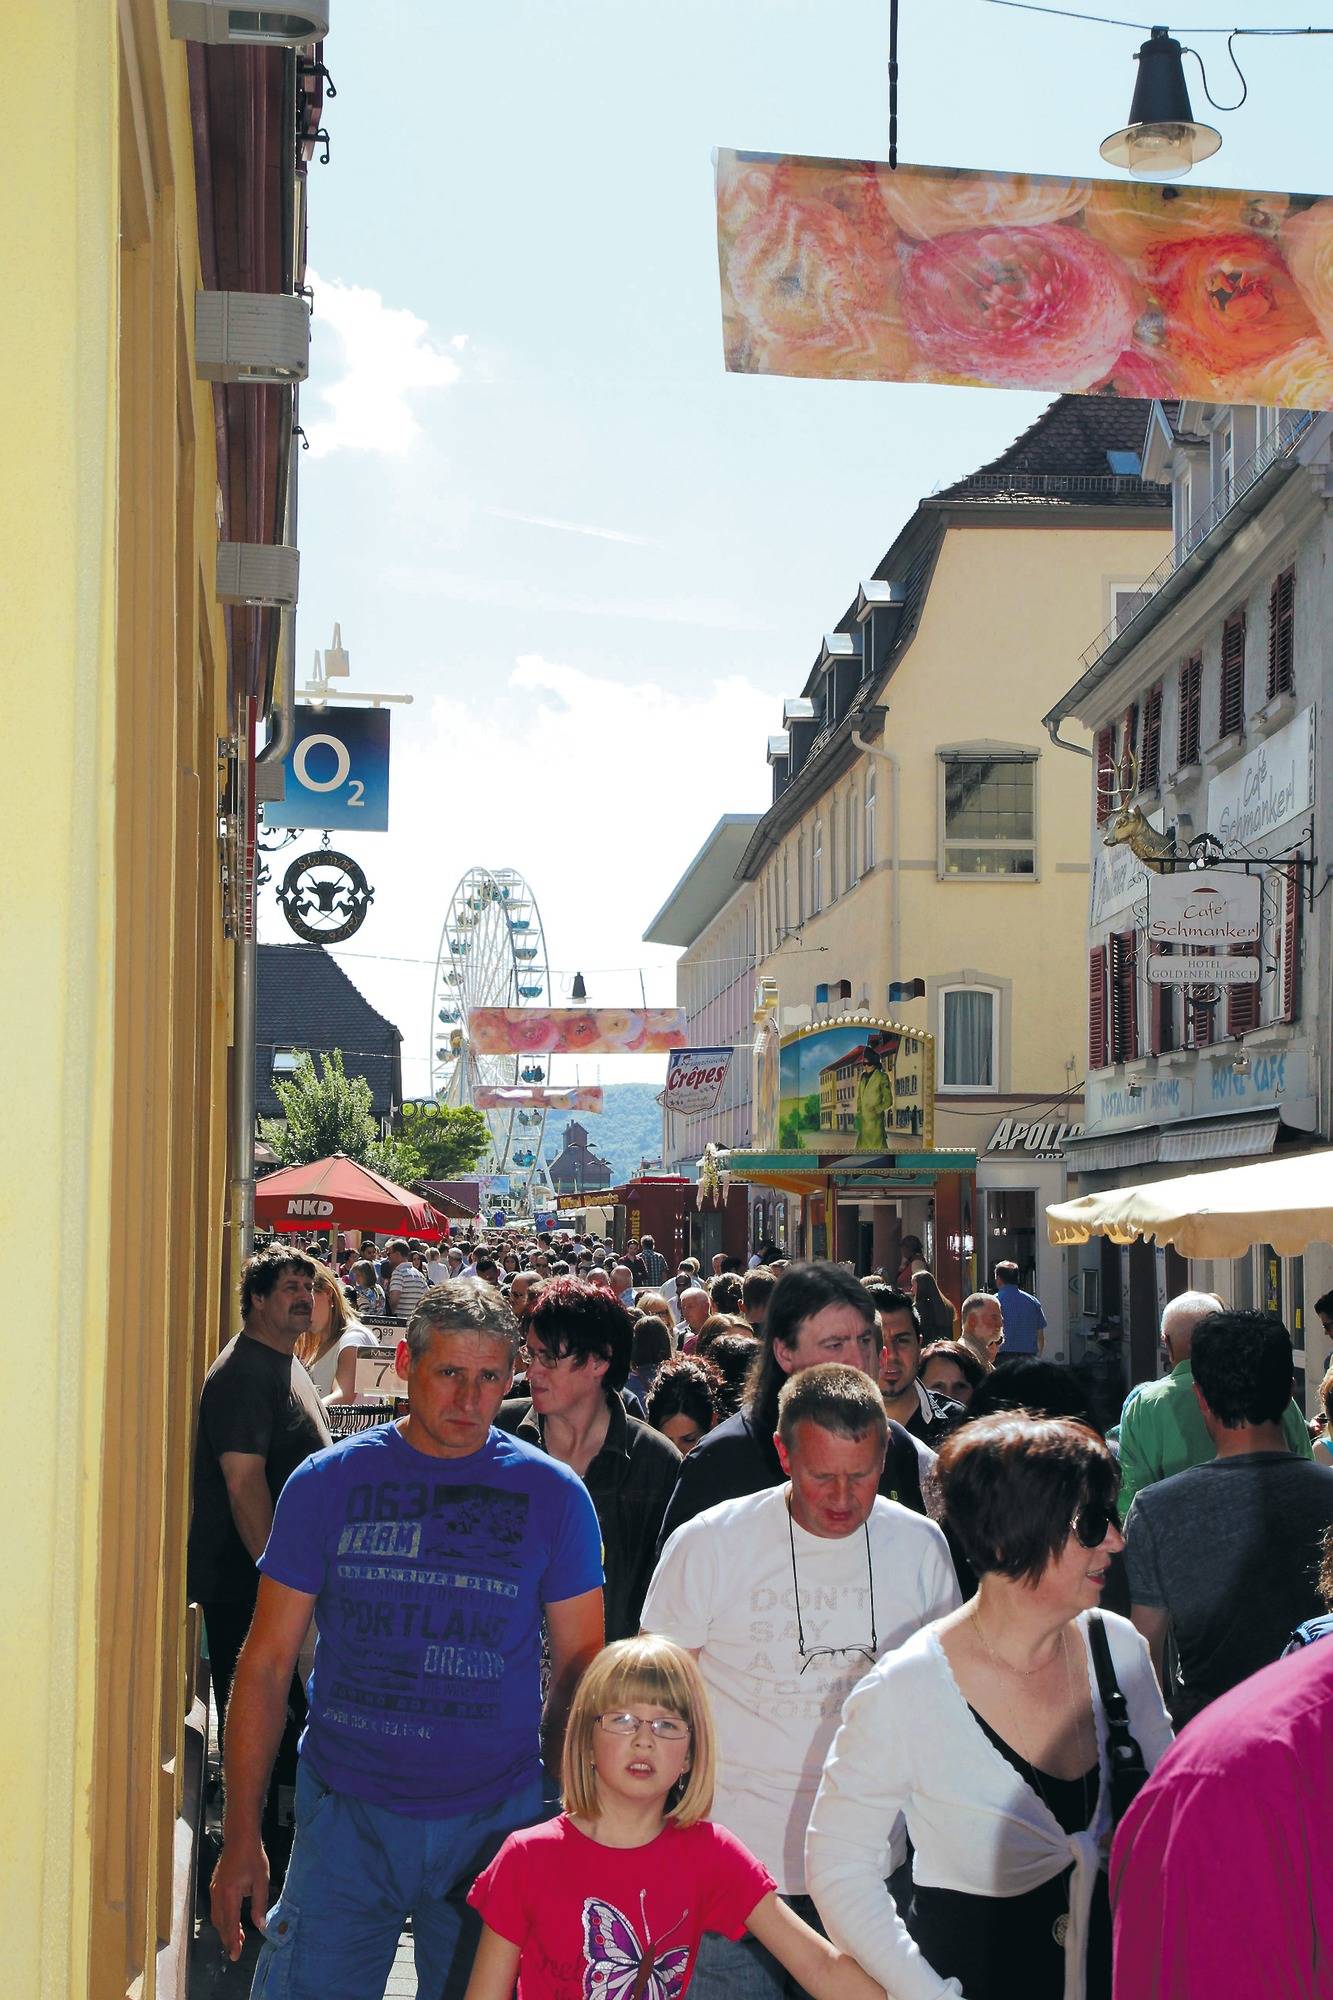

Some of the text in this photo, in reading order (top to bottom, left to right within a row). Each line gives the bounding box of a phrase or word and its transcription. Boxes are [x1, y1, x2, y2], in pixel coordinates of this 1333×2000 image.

[1151, 920, 1259, 938] Schmankerl
[1188, 960, 1221, 969] HOTEL
[1151, 969, 1257, 979] GOLDENER HIRSCH
[668, 1065, 725, 1091] Crêpes
[287, 1200, 334, 1216] NKD
[750, 1586, 869, 1612] DON'T
[749, 1619, 832, 1642] SAY
